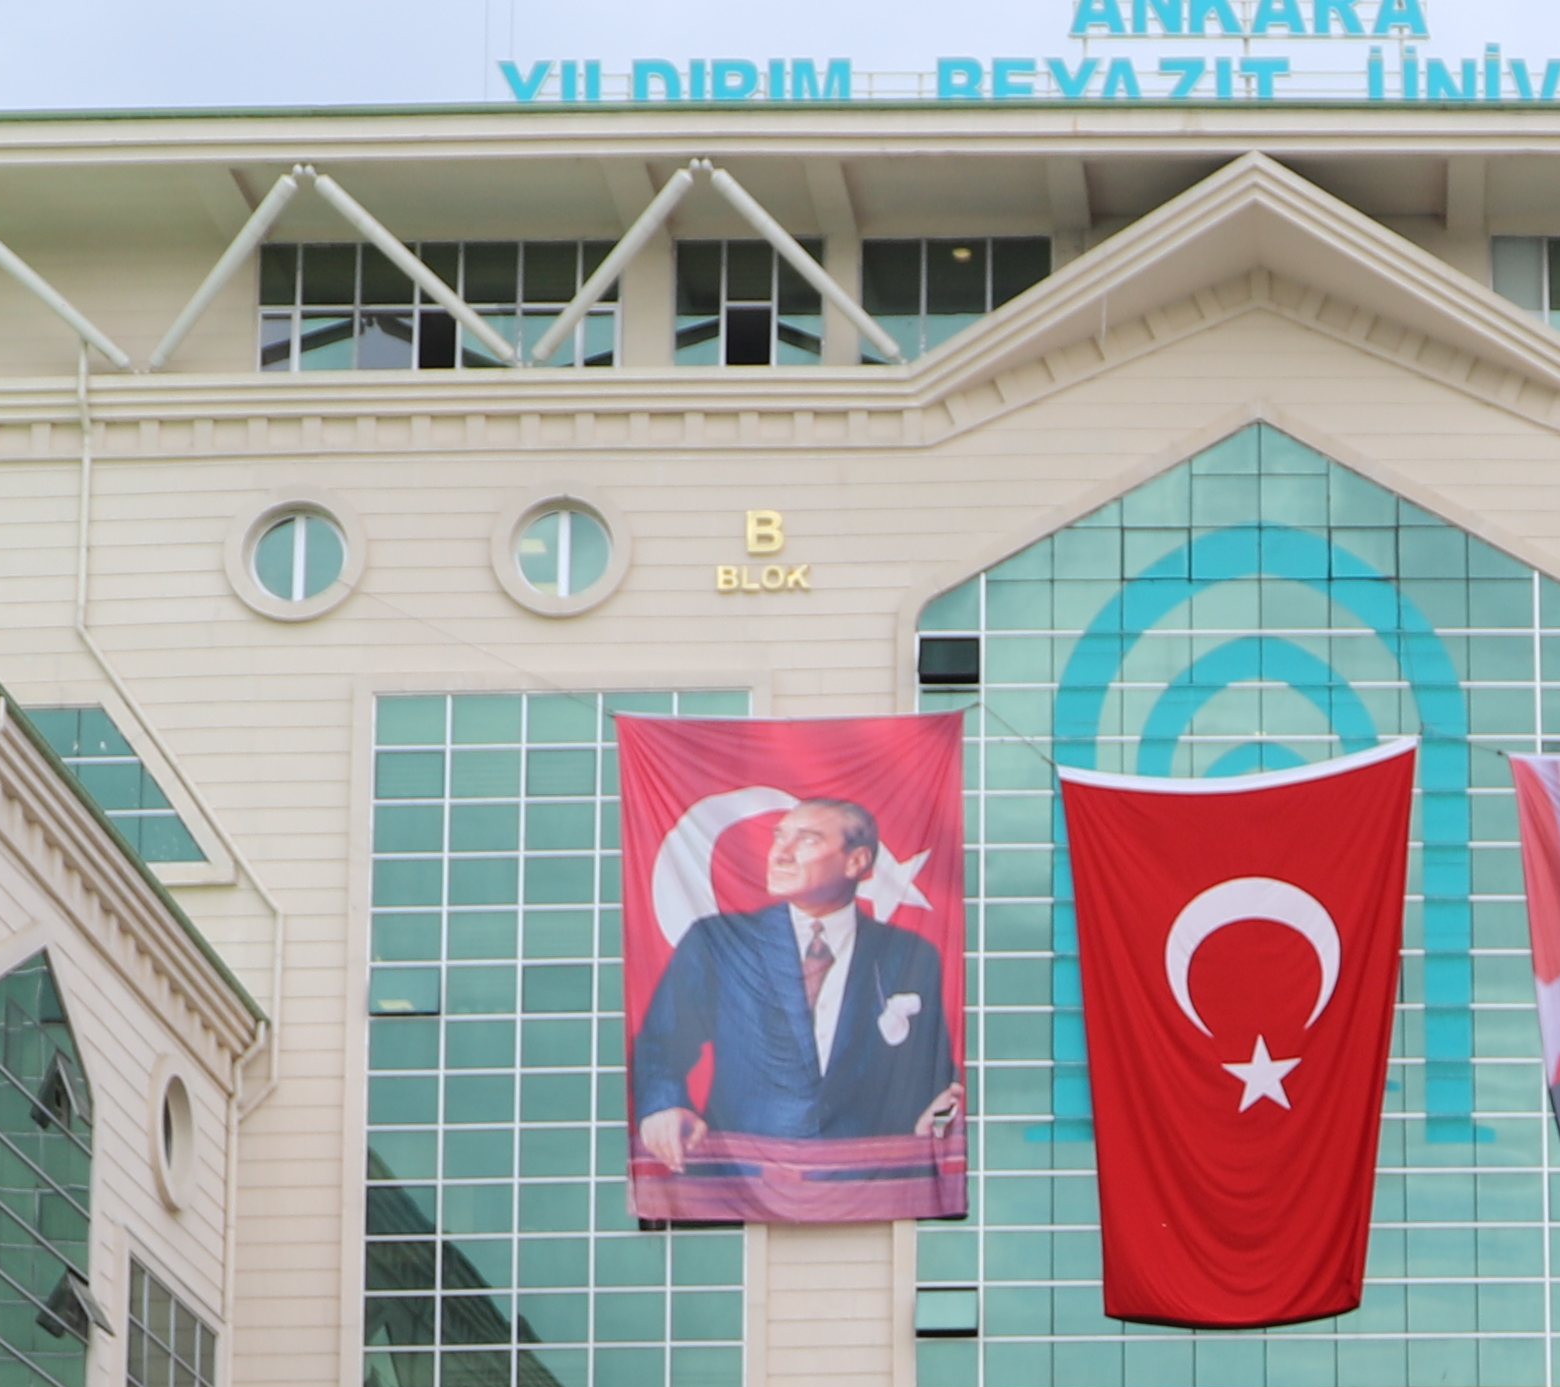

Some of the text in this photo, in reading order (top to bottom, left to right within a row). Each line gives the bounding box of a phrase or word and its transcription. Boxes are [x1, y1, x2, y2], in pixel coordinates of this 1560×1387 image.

[1068, 0, 1429, 38] ANKARA
[496, 57, 854, 102] YILDIRIM
[935, 55, 1292, 102] BEYAZIT
[746, 508, 785, 557] B
[716, 564, 811, 594] BLOK
